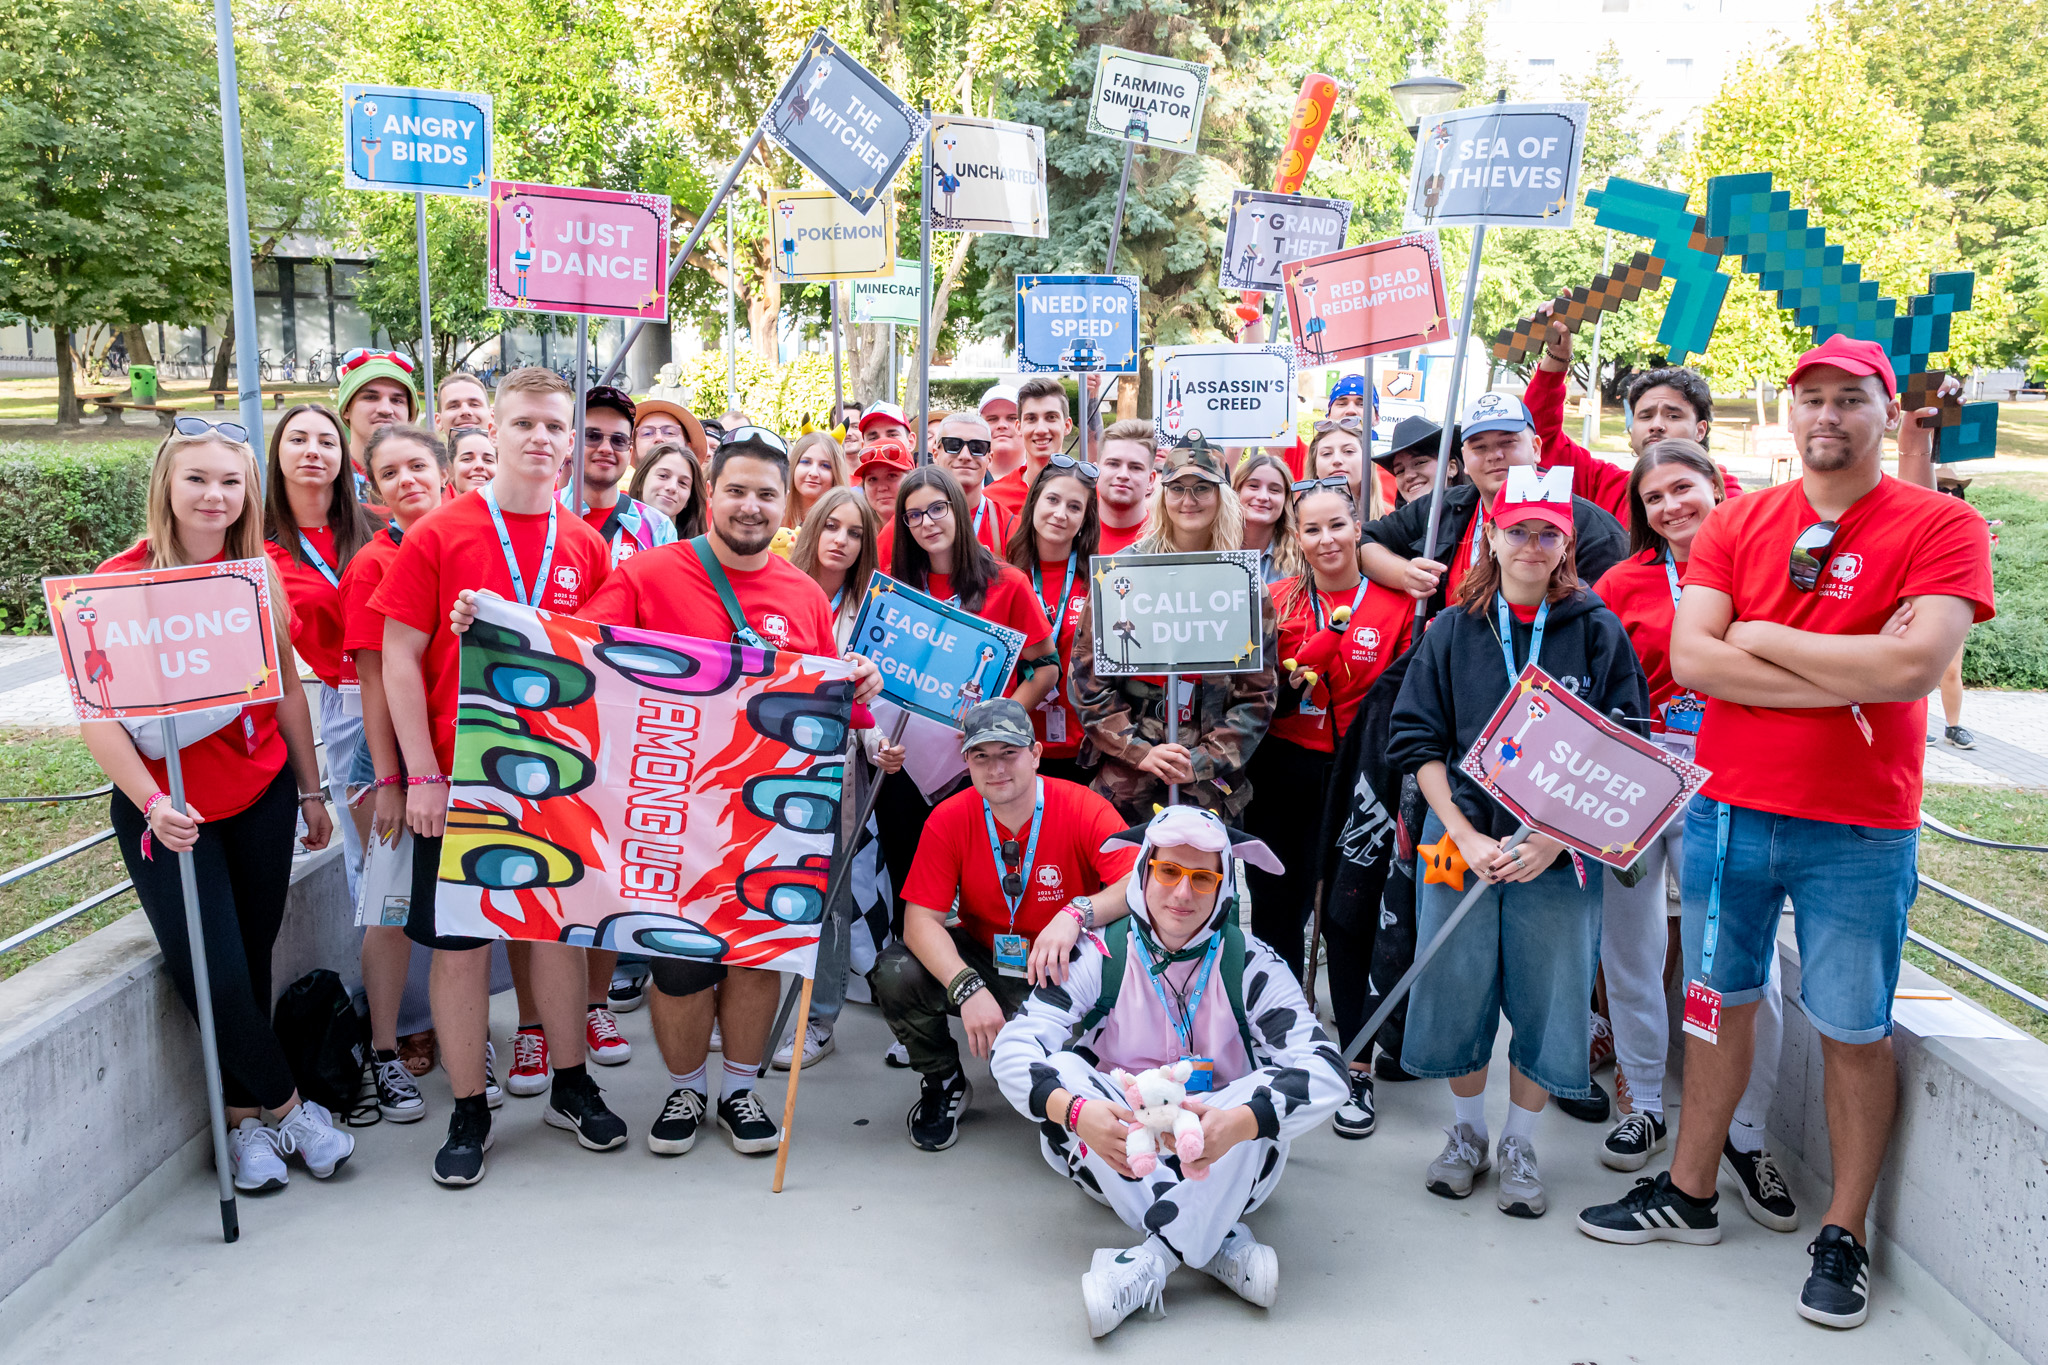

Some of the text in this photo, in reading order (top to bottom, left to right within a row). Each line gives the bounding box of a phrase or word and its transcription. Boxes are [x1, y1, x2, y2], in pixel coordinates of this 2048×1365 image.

[1113, 73, 1185, 98] FARMING
[845, 95, 882, 136] THE
[1103, 89, 1190, 118] SIMULATOR
[383, 114, 476, 140] ANGRY
[808, 97, 890, 175] WITCHER
[392, 141, 468, 166] BIRDS
[1459, 136, 1559, 161] SEA OF
[955, 162, 1038, 186] UNCHARTED
[1448, 166, 1562, 189] THIEVES
[557, 220, 634, 249] JUST
[797, 223, 883, 241] POKÉMON
[1269, 213, 1338, 236] GRAND
[1273, 236, 1330, 257] THEFT
[541, 250, 648, 281] DANCE
[856, 284, 921, 297] MINECRAF
[1329, 267, 1421, 299] RED DEAD
[1031, 296, 1128, 314] NEED FOR
[1321, 282, 1430, 317] REDEMPTION
[1050, 319, 1113, 337] SPEED
[1185, 380, 1285, 394] ASSASSIN'S
[1207, 397, 1262, 410] CREED
[1505, 465, 1575, 503] M
[1132, 590, 1247, 615] CALL OF
[104, 607, 252, 649] AMONG
[869, 626, 898, 649] OF
[876, 602, 958, 653] LEAGUE
[1152, 620, 1229, 643] DUTY
[159, 648, 211, 679] US
[1550, 740, 1647, 806] SUPER
[619, 698, 701, 902] AMONG US!
[1528, 760, 1630, 827] MARIO
[1689, 989, 1720, 1007] STAFF
